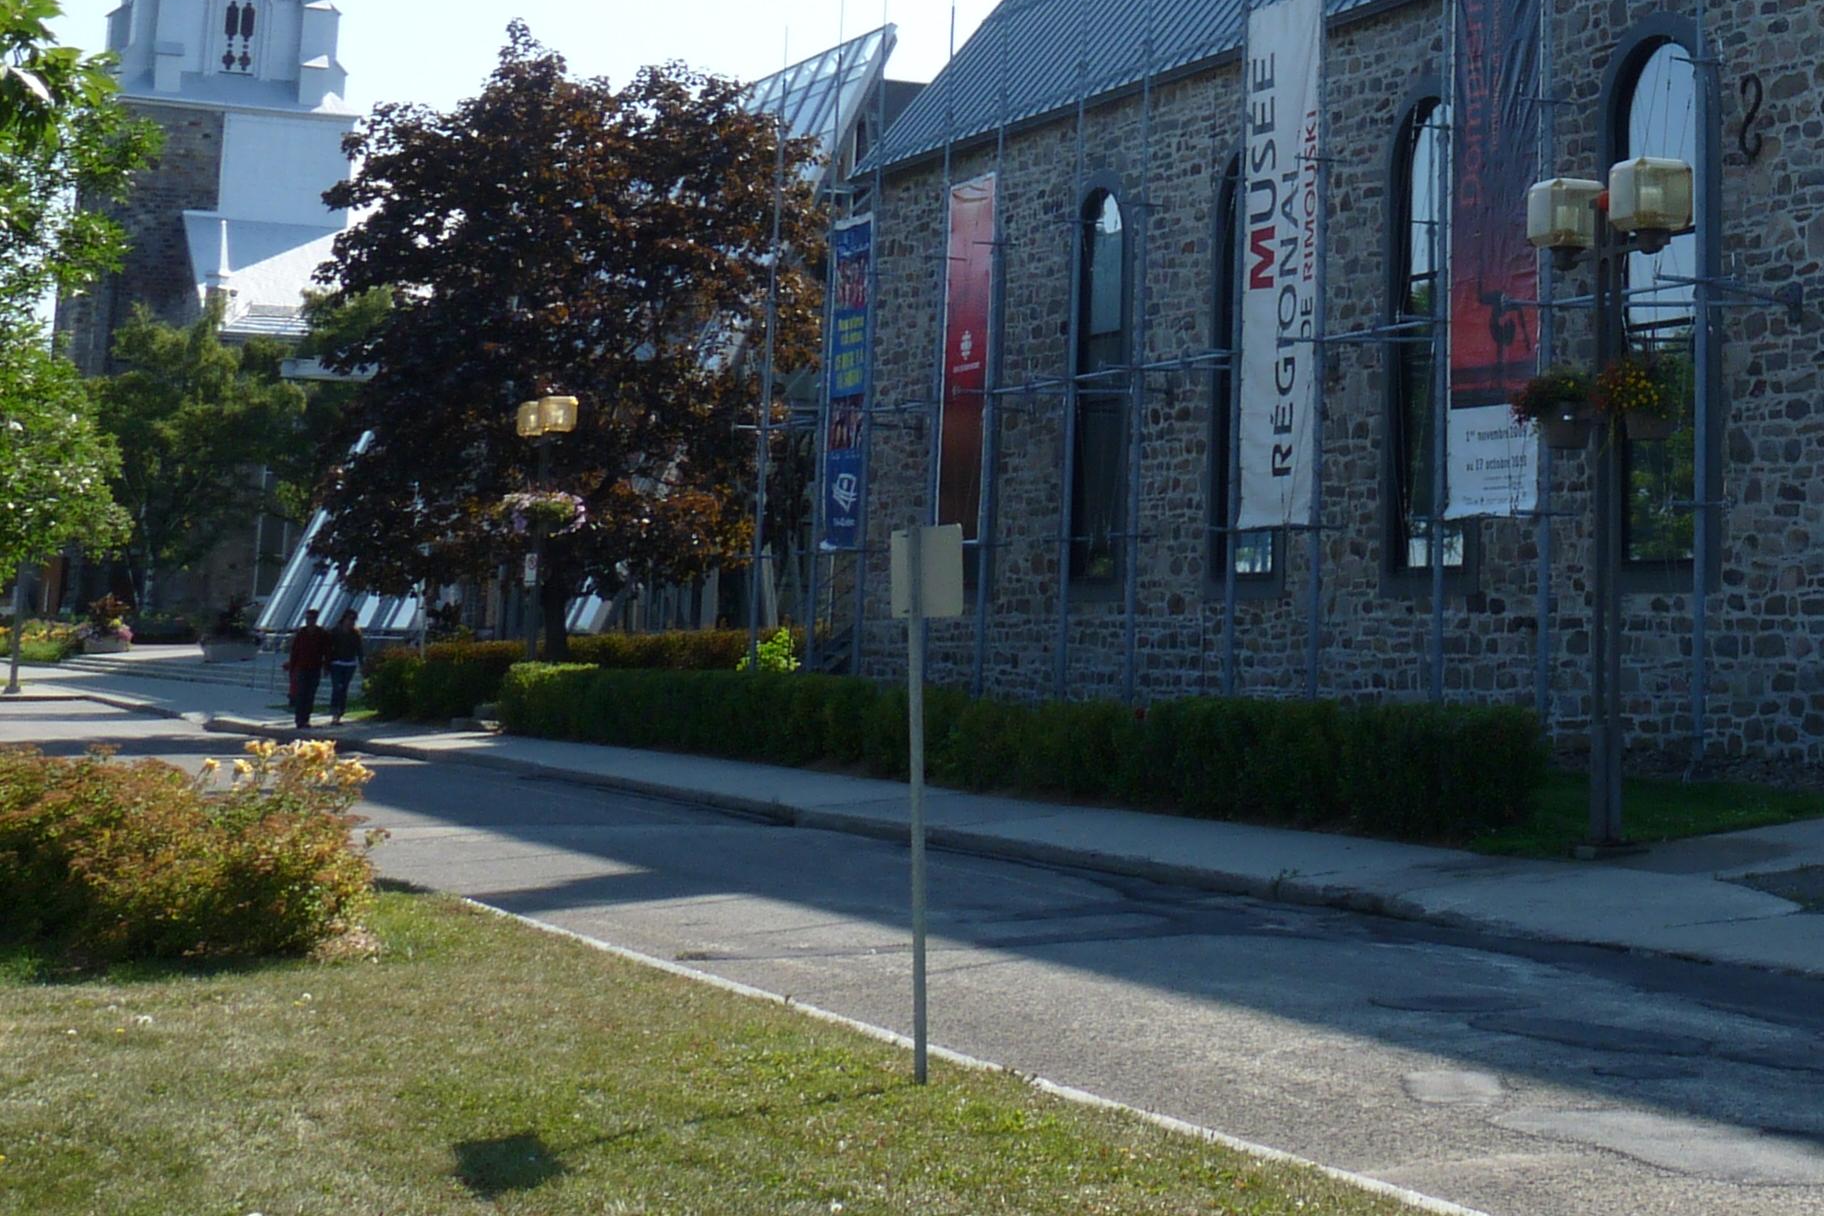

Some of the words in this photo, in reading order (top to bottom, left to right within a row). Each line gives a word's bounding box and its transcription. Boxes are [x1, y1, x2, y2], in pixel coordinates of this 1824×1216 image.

[1246, 51, 1278, 291] MUSÉE
[1301, 111, 1319, 283] RIMOUSKI
[1270, 152, 1301, 478] RÉGIONAL
[1299, 297, 1314, 341] DE
[1478, 428, 1509, 440] novembre
